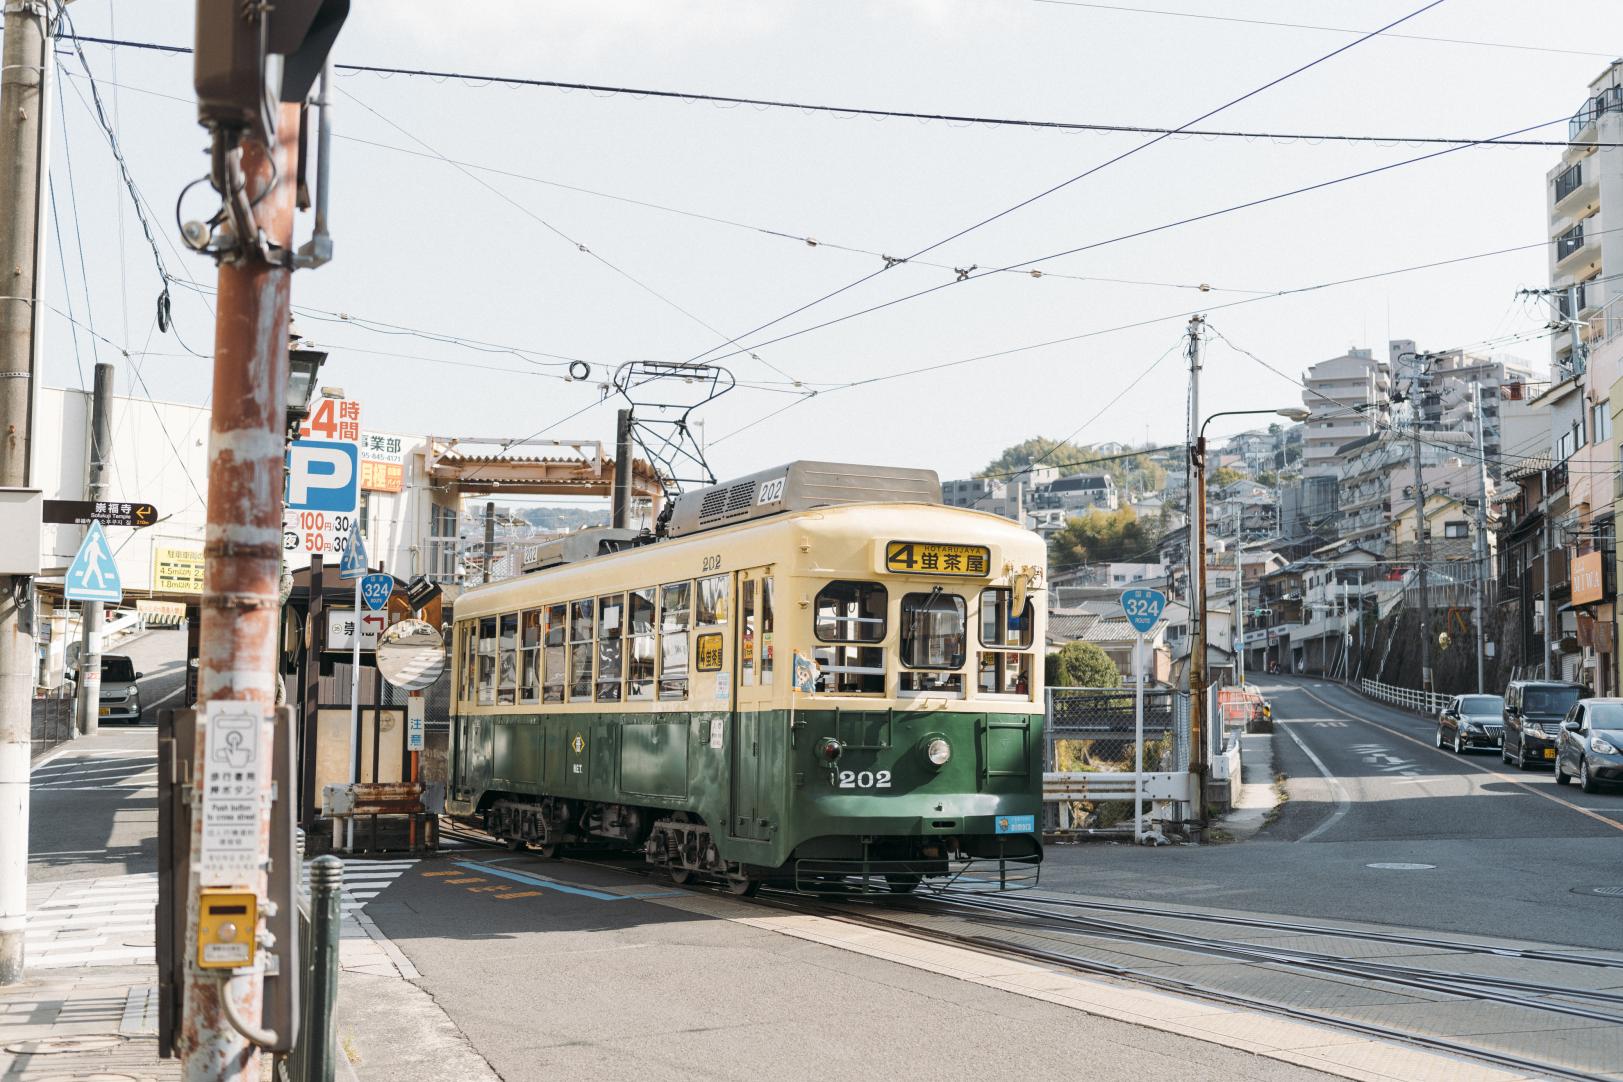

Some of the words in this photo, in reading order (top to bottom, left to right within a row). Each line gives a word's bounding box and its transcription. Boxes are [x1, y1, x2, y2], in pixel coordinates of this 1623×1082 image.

[290, 446, 353, 504] P
[759, 481, 783, 504] 202
[95, 502, 132, 514] 崇福寺
[112, 513, 132, 521] Temple
[524, 545, 538, 563] 202
[888, 544, 918, 569] 4
[924, 545, 981, 554] HOTARUJAYA
[702, 554, 722, 572] 202
[364, 583, 389, 598] 324
[1126, 599, 1160, 617] 324
[410, 717, 422, 747] 注意
[838, 770, 892, 789] 202
